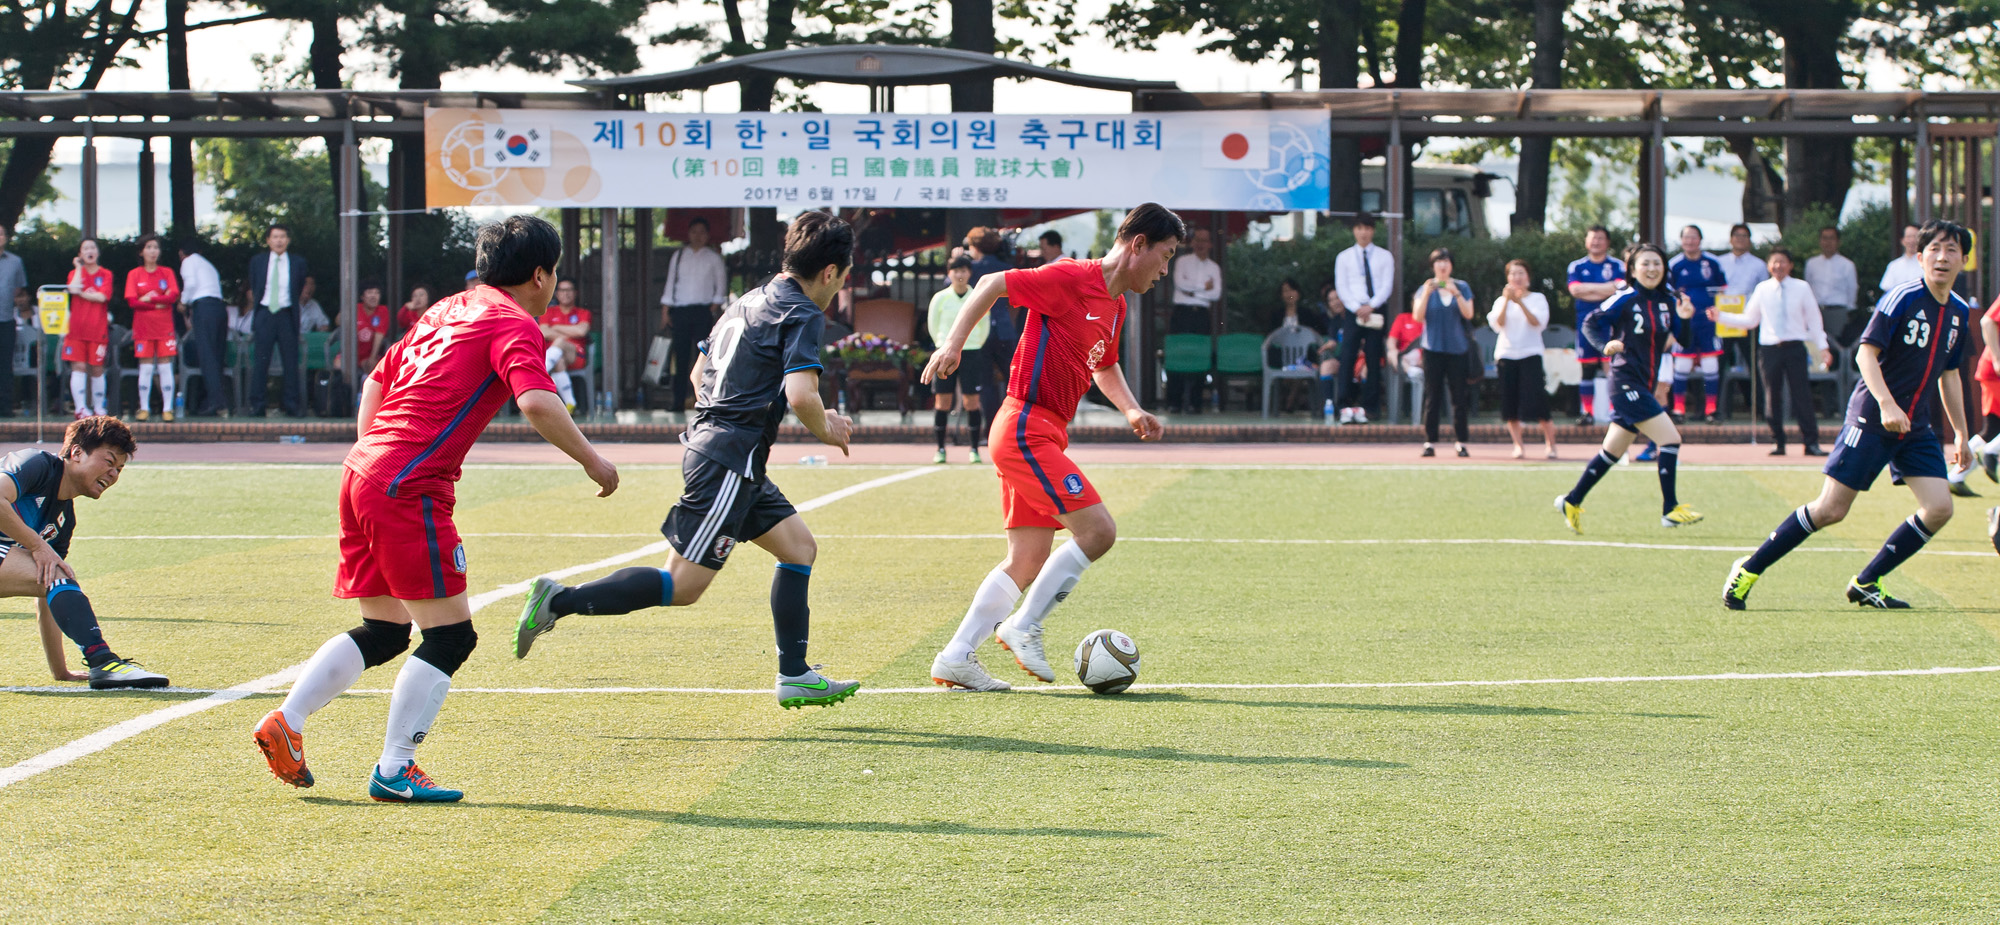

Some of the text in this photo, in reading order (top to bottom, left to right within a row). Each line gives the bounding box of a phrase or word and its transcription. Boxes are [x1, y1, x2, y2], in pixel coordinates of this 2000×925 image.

[593, 119, 711, 149] 제10회
[853, 119, 996, 150] 국회의원
[1019, 119, 1161, 150] 축구대회
[672, 156, 764, 179] (第10回
[864, 157, 959, 178] 國會議員
[744, 187, 798, 201] 2017년
[808, 187, 833, 201] 6월
[844, 187, 877, 201] 17일
[918, 187, 950, 201] 국회
[959, 187, 1008, 202] 운동장
[1633, 313, 1645, 335] 2
[1903, 319, 1931, 349] 33
[711, 317, 746, 399] 9
